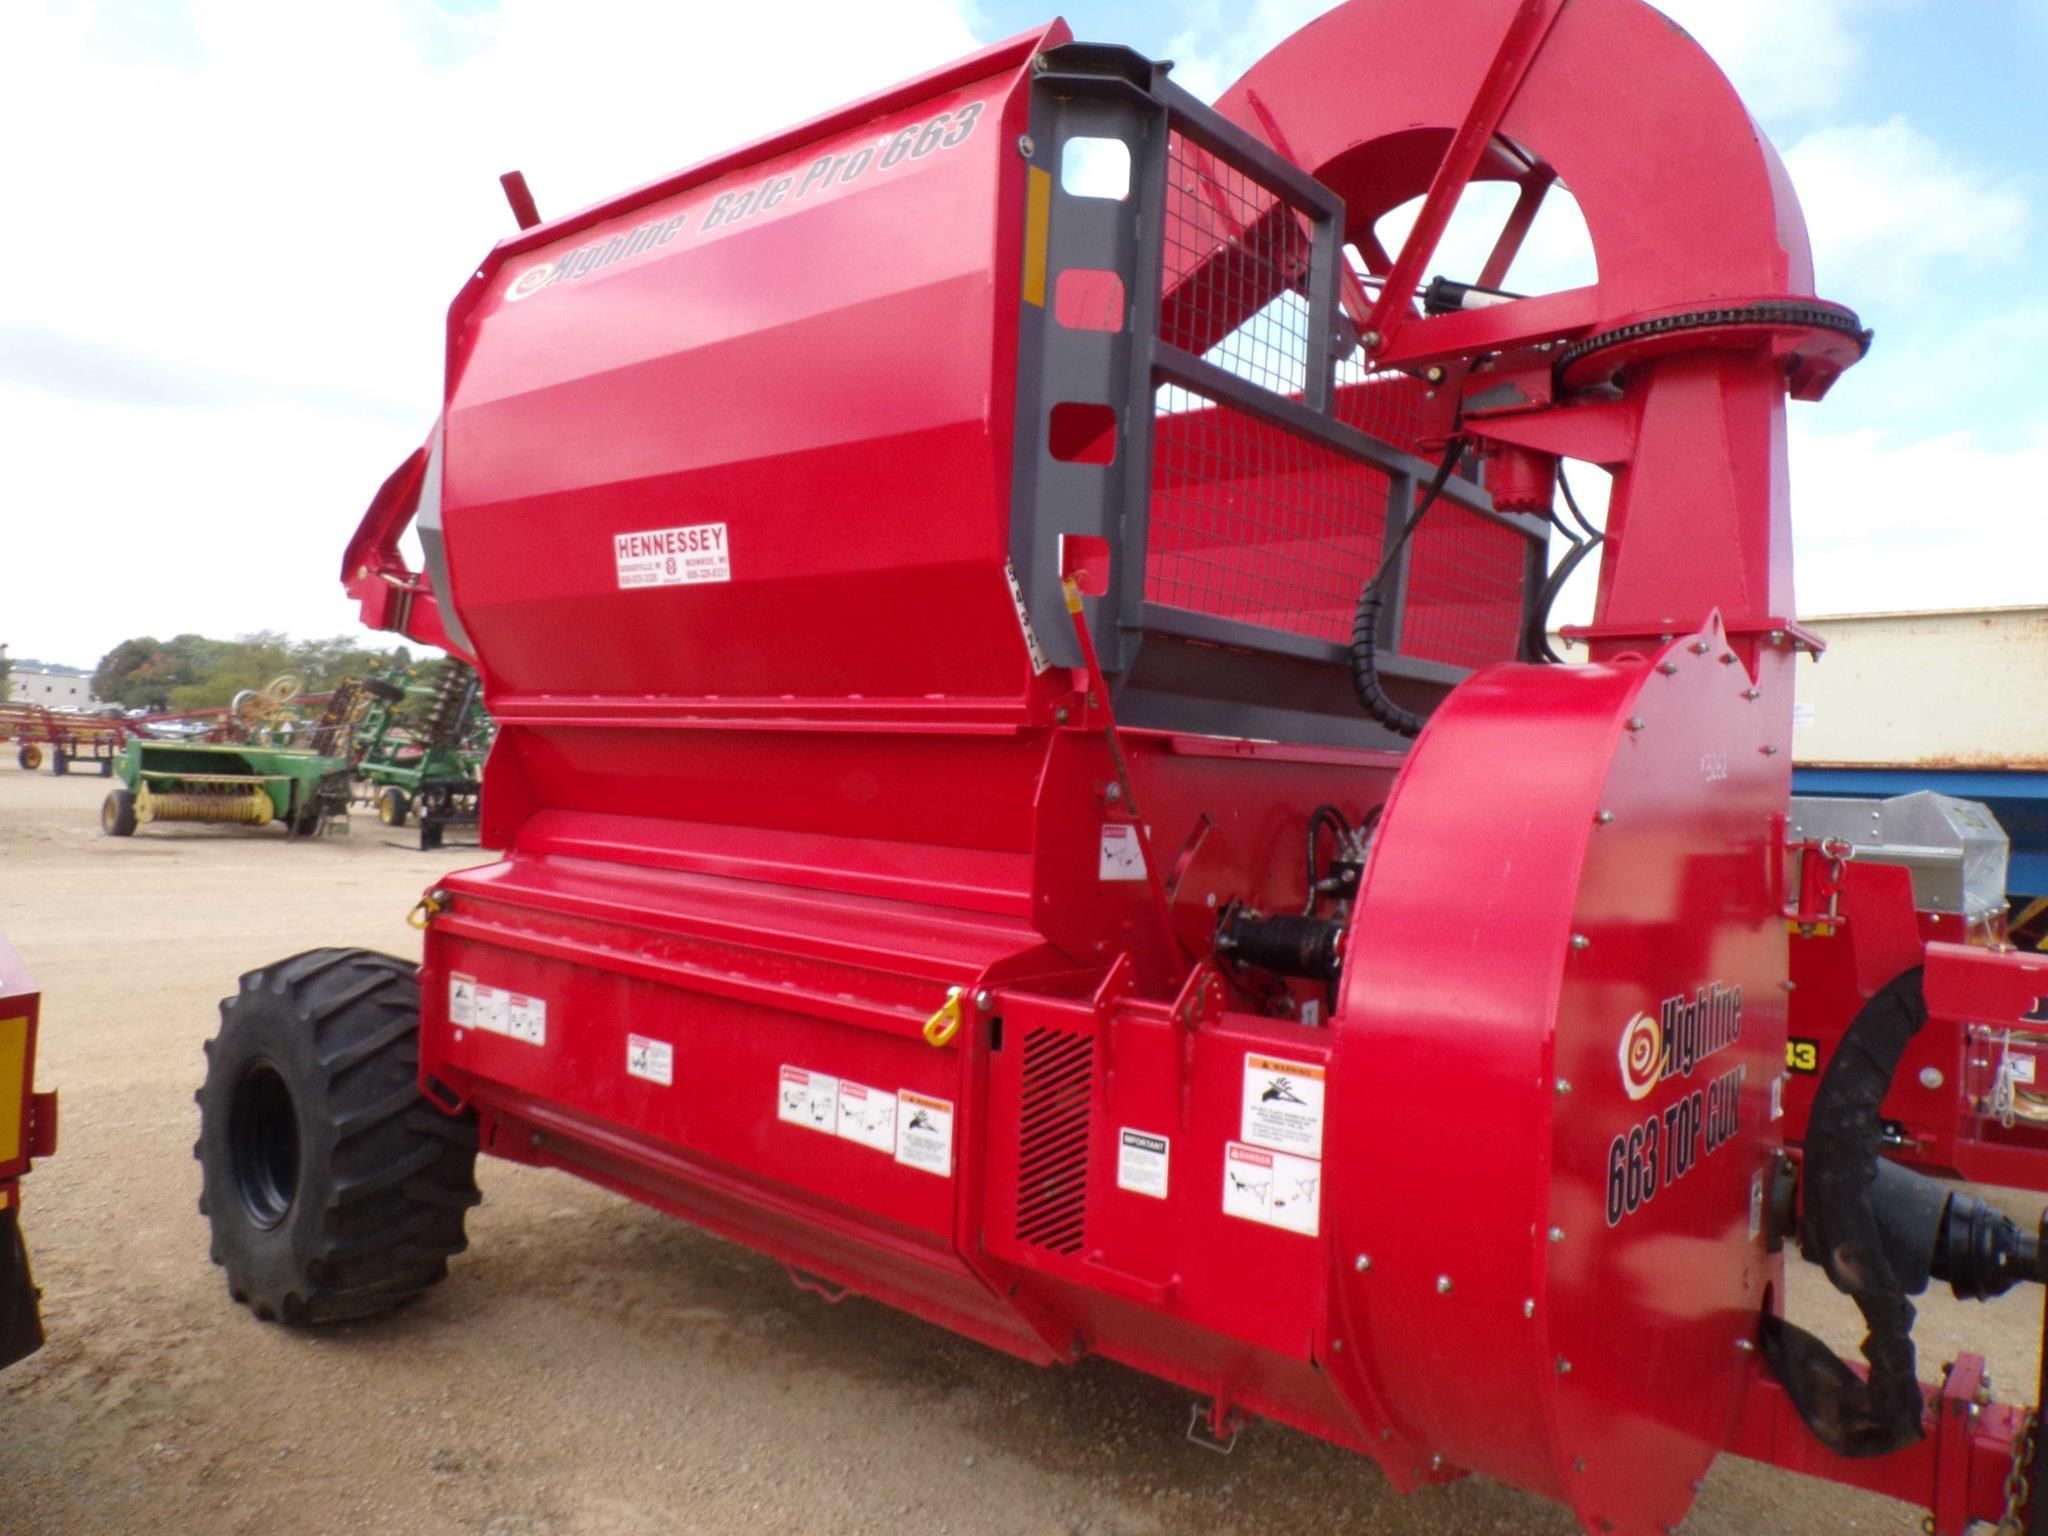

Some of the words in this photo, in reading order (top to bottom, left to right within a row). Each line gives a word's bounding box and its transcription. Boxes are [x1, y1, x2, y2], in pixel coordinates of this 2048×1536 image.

[551, 214, 687, 287] Highline
[699, 178, 792, 234] Bale
[797, 148, 873, 198] Pro
[879, 101, 985, 170] 663
[618, 528, 722, 557] HENNESSEY
[1660, 980, 1743, 1080] Highline
[1124, 1134, 1164, 1150] IMPORTANT
[1606, 1114, 1660, 1227] 663
[1664, 1089, 1702, 1187] TOP
[1705, 1069, 1742, 1155] GUN
